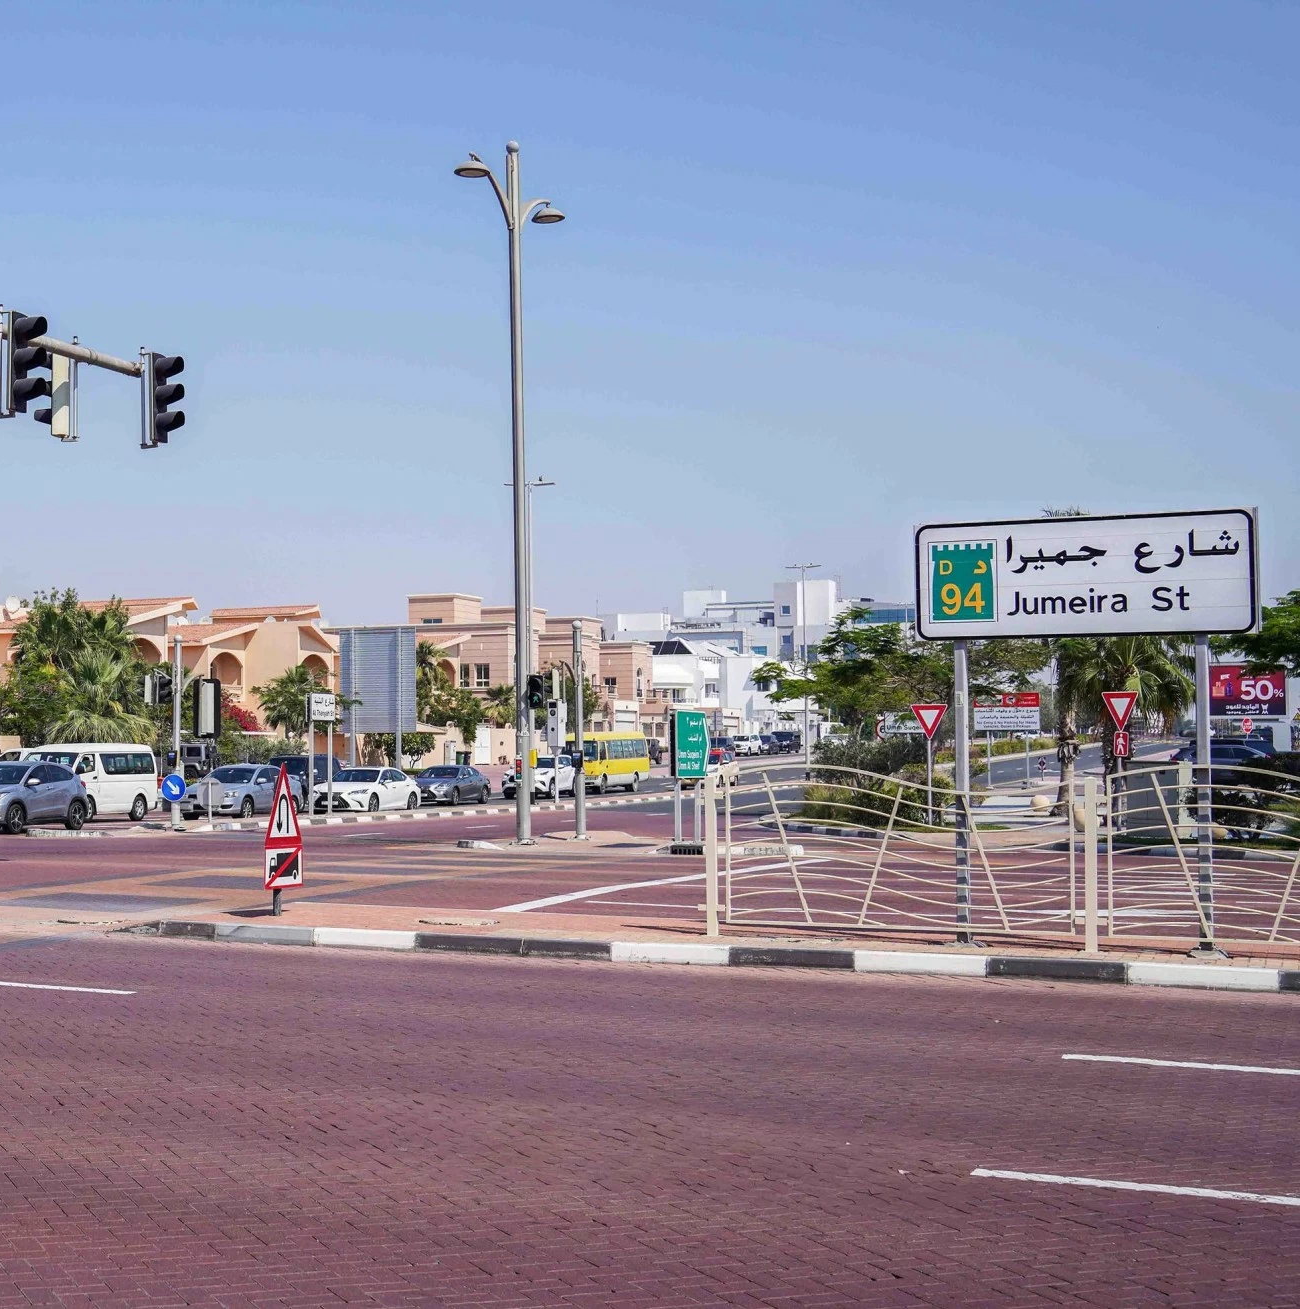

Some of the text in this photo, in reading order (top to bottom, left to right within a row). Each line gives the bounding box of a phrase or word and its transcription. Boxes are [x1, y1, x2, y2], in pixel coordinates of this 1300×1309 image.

[1005, 529, 1241, 574] شارع جميرا
[939, 560, 953, 576] D
[973, 559, 988, 575] د
[940, 582, 986, 615] 94
[1007, 585, 1191, 617] Jumeira St
[1240, 680, 1284, 701] 50%
